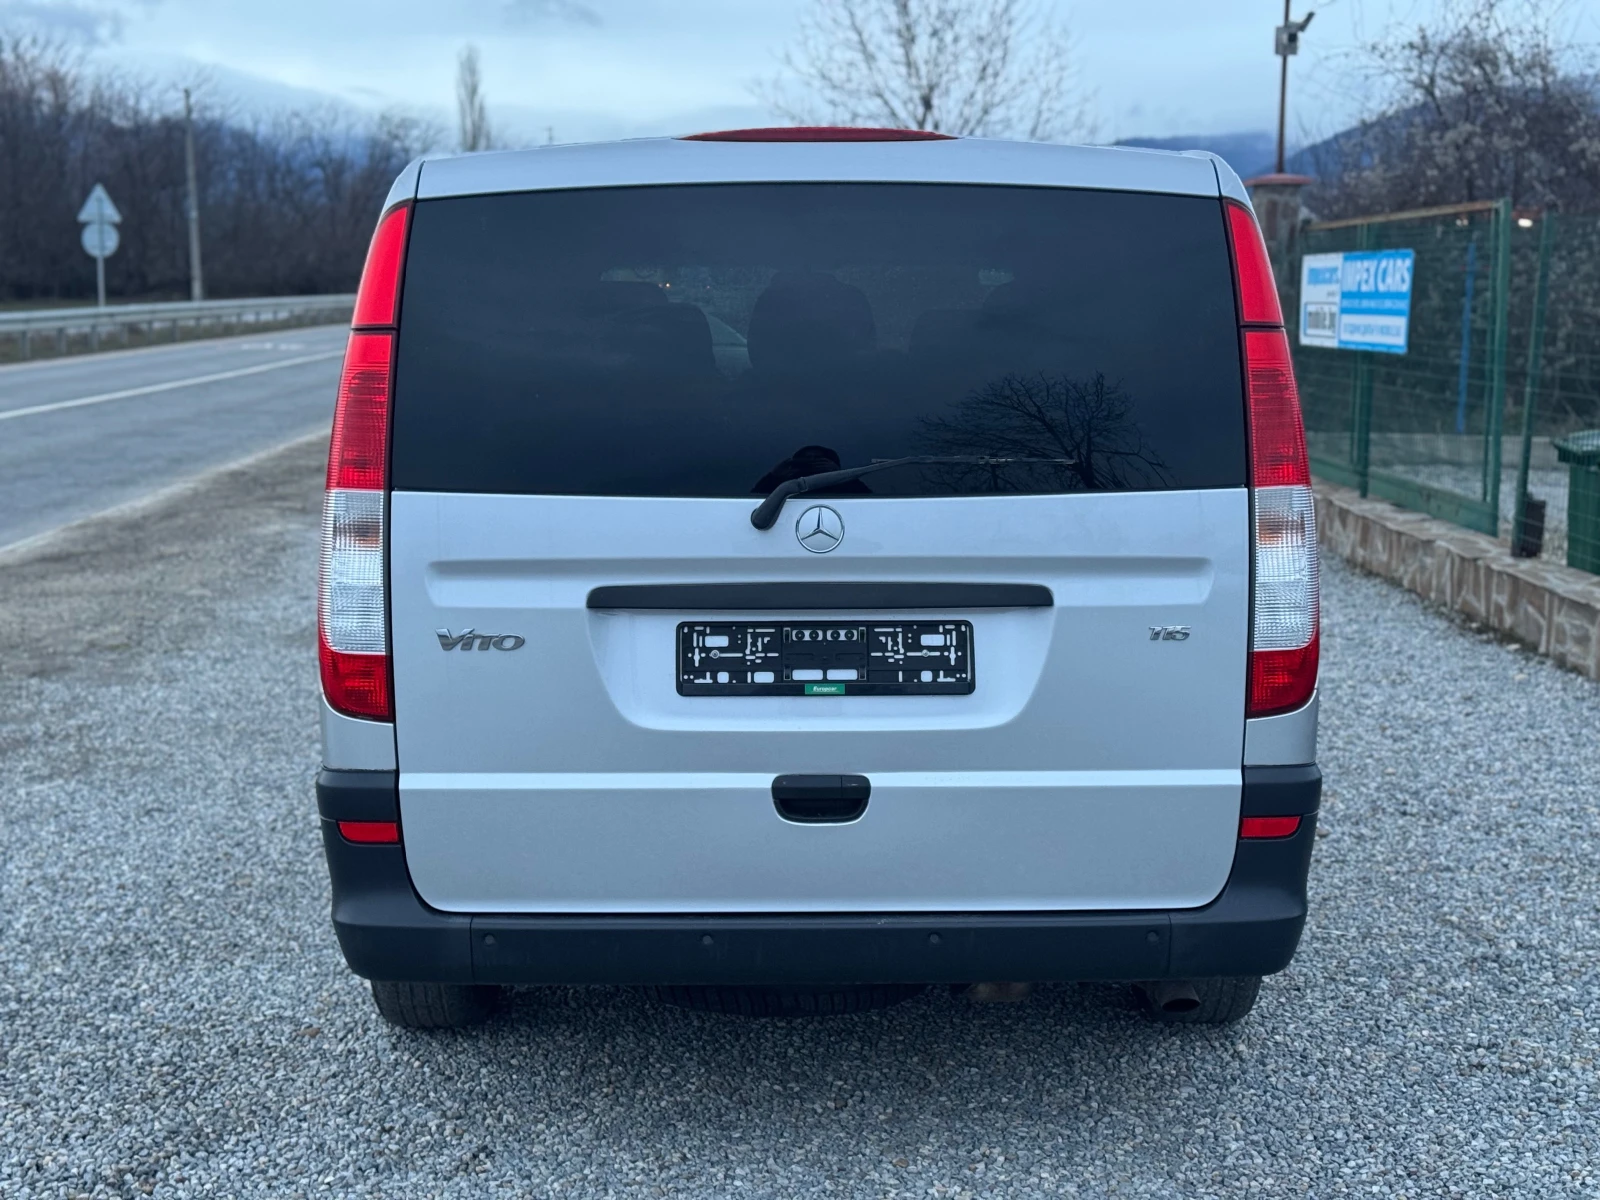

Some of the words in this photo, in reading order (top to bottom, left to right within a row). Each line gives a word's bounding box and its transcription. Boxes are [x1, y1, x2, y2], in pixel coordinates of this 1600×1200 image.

[1377, 257, 1411, 293] CARS
[1148, 625, 1192, 641] 115
[812, 685, 838, 693] Europcar
